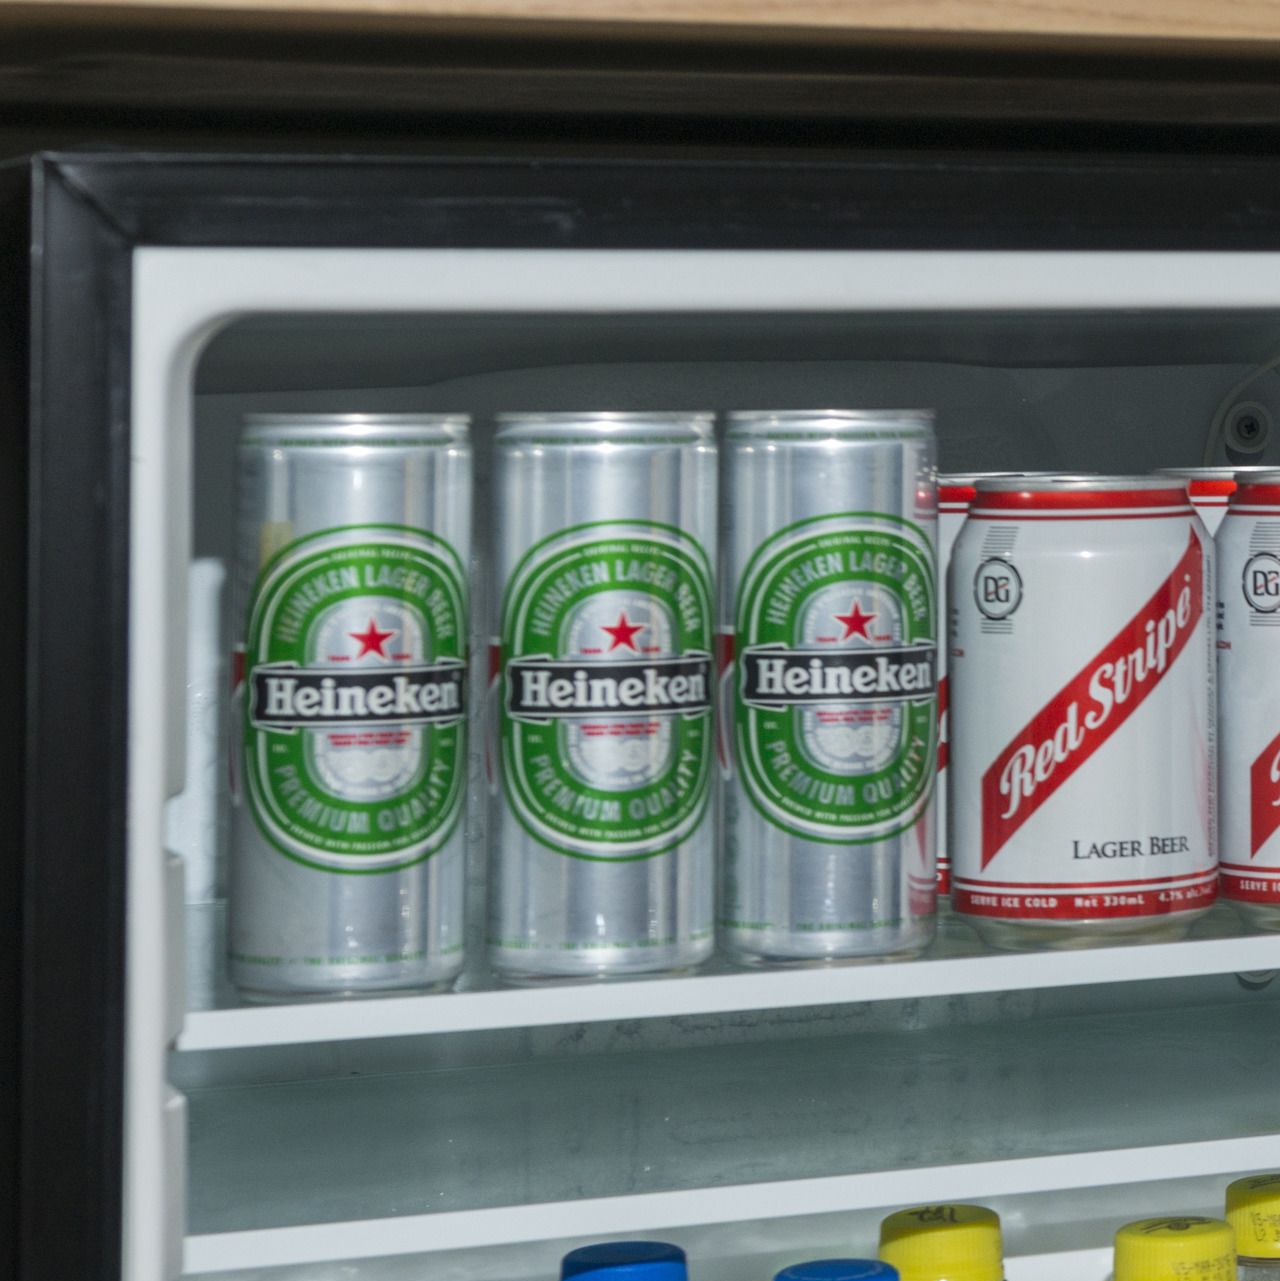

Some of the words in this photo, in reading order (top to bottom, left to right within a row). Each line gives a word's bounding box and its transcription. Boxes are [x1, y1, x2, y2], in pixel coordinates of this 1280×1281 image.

[276, 565, 360, 643] HEINEKEN
[364, 564, 429, 598] LAGER
[428, 583, 454, 640] BEER
[530, 559, 611, 637] HEINEKEN
[616, 559, 677, 593] LAGER
[677, 581, 700, 633] BEER
[766, 551, 844, 626] HEINEKEN
[849, 549, 907, 580] LAGER
[902, 570, 928, 622] BEER
[264, 677, 460, 717] Heineken
[520, 668, 707, 709] Heineken
[755, 656, 932, 696] Heineken
[1000, 701, 1085, 820] Red
[1084, 574, 1192, 730] Stripe
[274, 763, 370, 834] PREMIUM
[376, 758, 451, 834] QUALITY
[529, 753, 622, 823] PREMIUM
[628, 748, 699, 822] QUALITY
[767, 738, 857, 807] PREMIUM
[862, 734, 926, 806] QUALITY
[1072, 839, 1144, 860] LAGER
[1149, 835, 1190, 856] BEER
[1001, 894, 1020, 908] ICE
[1025, 896, 1058, 909] COLD
[1239, 879, 1268, 892] SERVE
